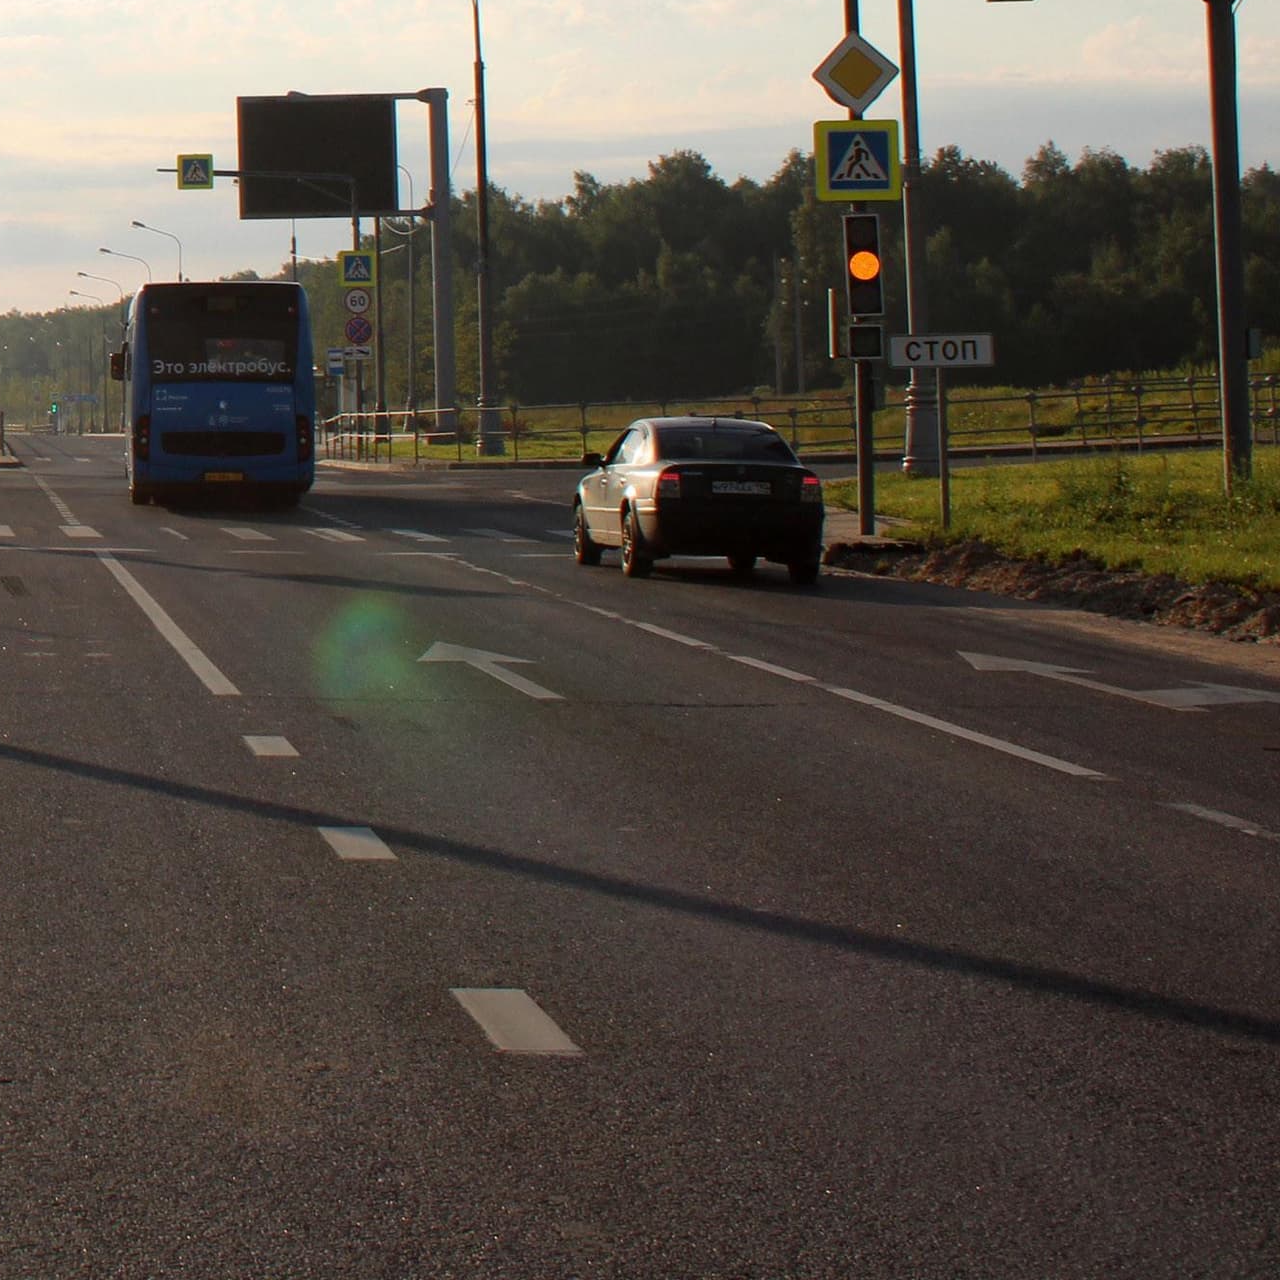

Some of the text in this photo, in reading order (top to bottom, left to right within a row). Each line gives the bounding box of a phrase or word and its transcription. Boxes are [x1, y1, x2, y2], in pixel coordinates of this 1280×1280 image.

[350, 295, 366, 307] 60
[905, 340, 977, 361] СТОП
[153, 357, 291, 376] Это электробус.
